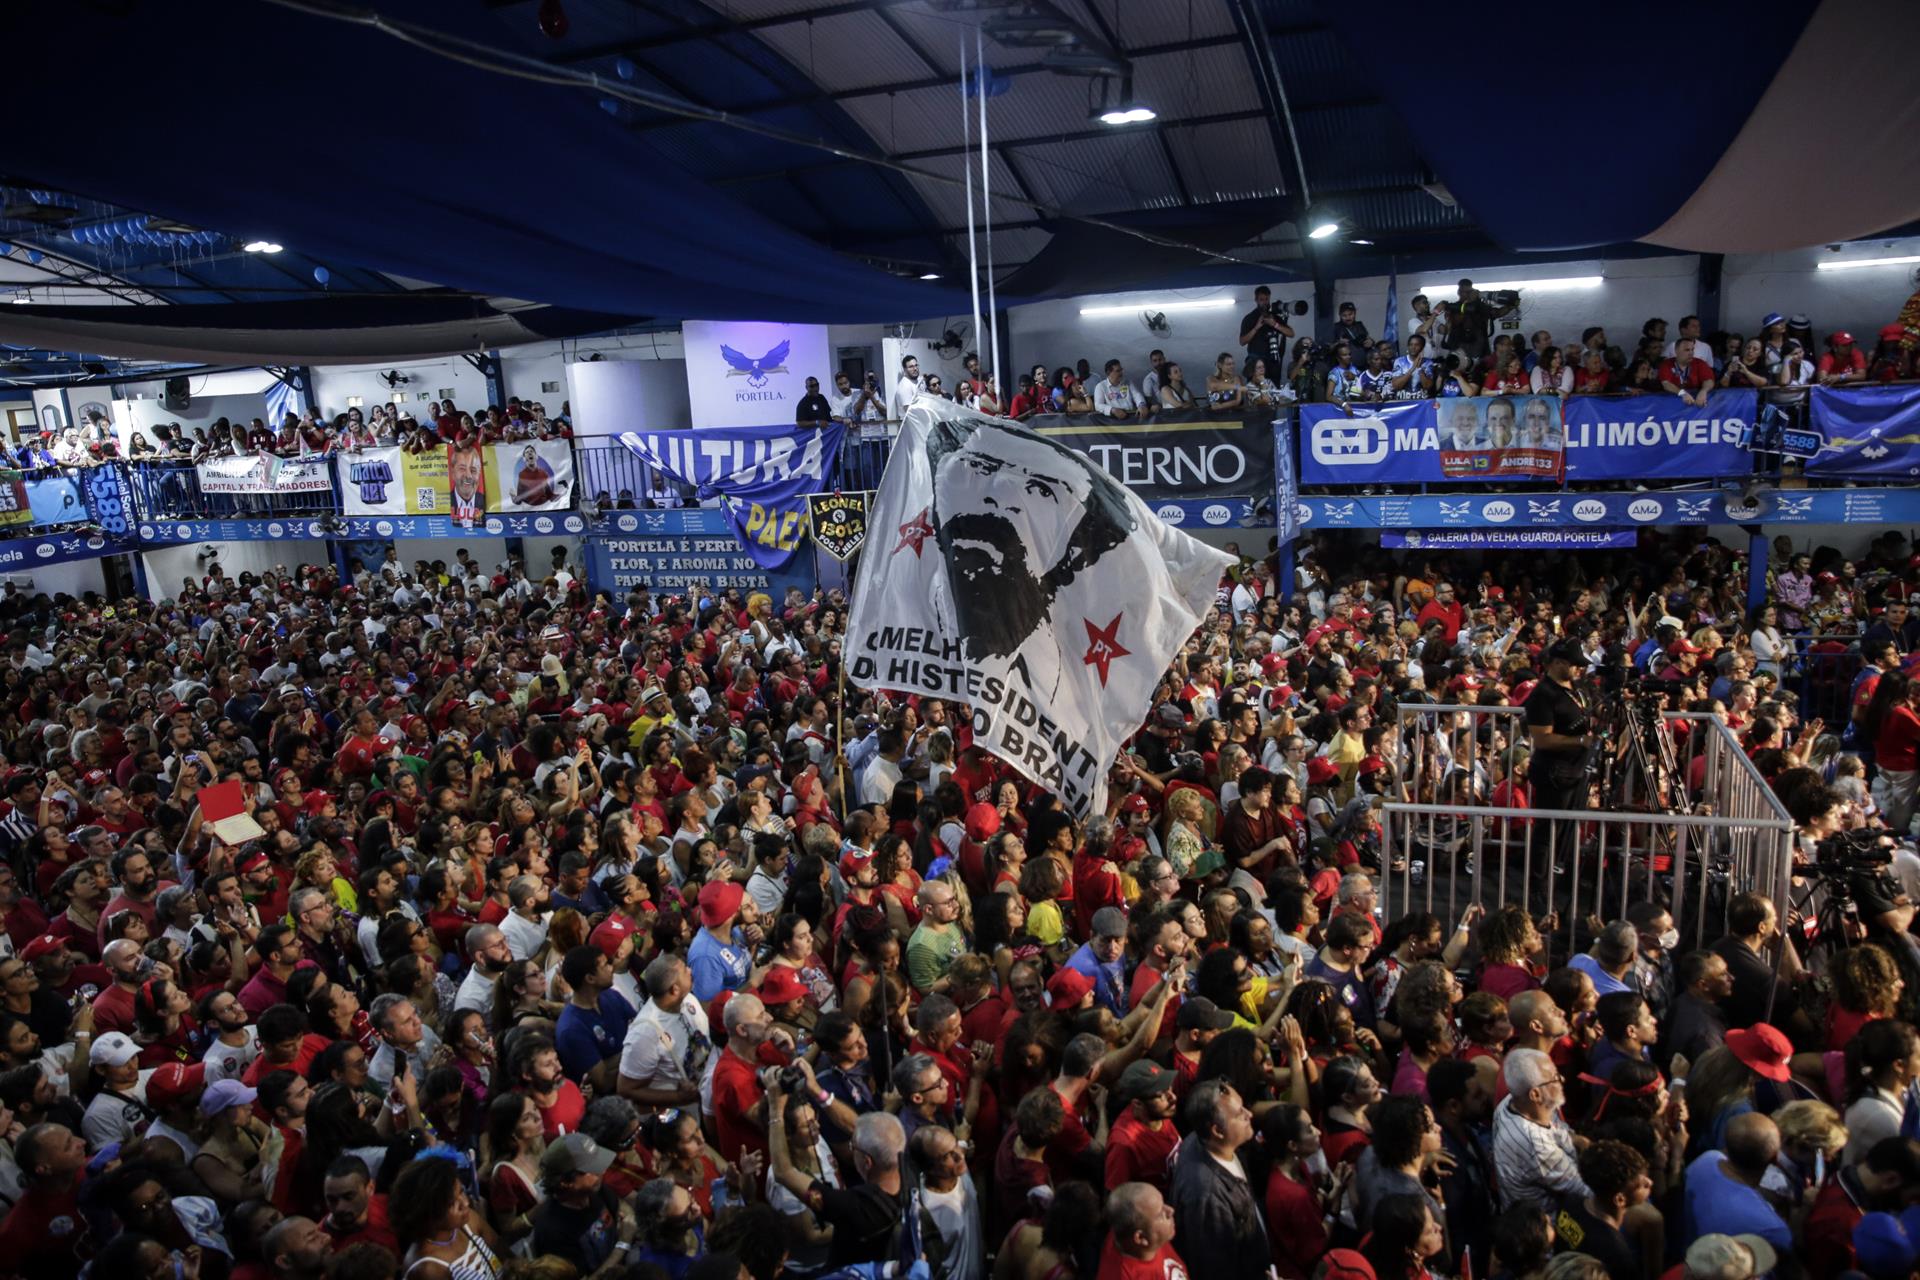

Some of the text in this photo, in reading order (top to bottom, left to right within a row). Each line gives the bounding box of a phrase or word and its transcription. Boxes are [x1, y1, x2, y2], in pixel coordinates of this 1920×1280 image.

[1596, 416, 1744, 447] IMÓVEIS
[1444, 456, 1471, 465] LULA
[1473, 457, 1489, 468] 13
[202, 483, 238, 492] CAPITAL
[248, 479, 330, 492] TRALHADORES!
[91, 464, 127, 533] 5588
[813, 496, 864, 516] LEONEL
[820, 518, 864, 539] 13012
[679, 536, 690, 552] É
[818, 534, 841, 553] FOGO
[1427, 531, 1612, 544] GALERIA DA VELHA GUARDA PORTELA
[610, 557, 756, 572] FLOR, E AROMA NO
[614, 574, 769, 588] PARA SENTIR BASTA
[1091, 638, 1113, 662] PT
